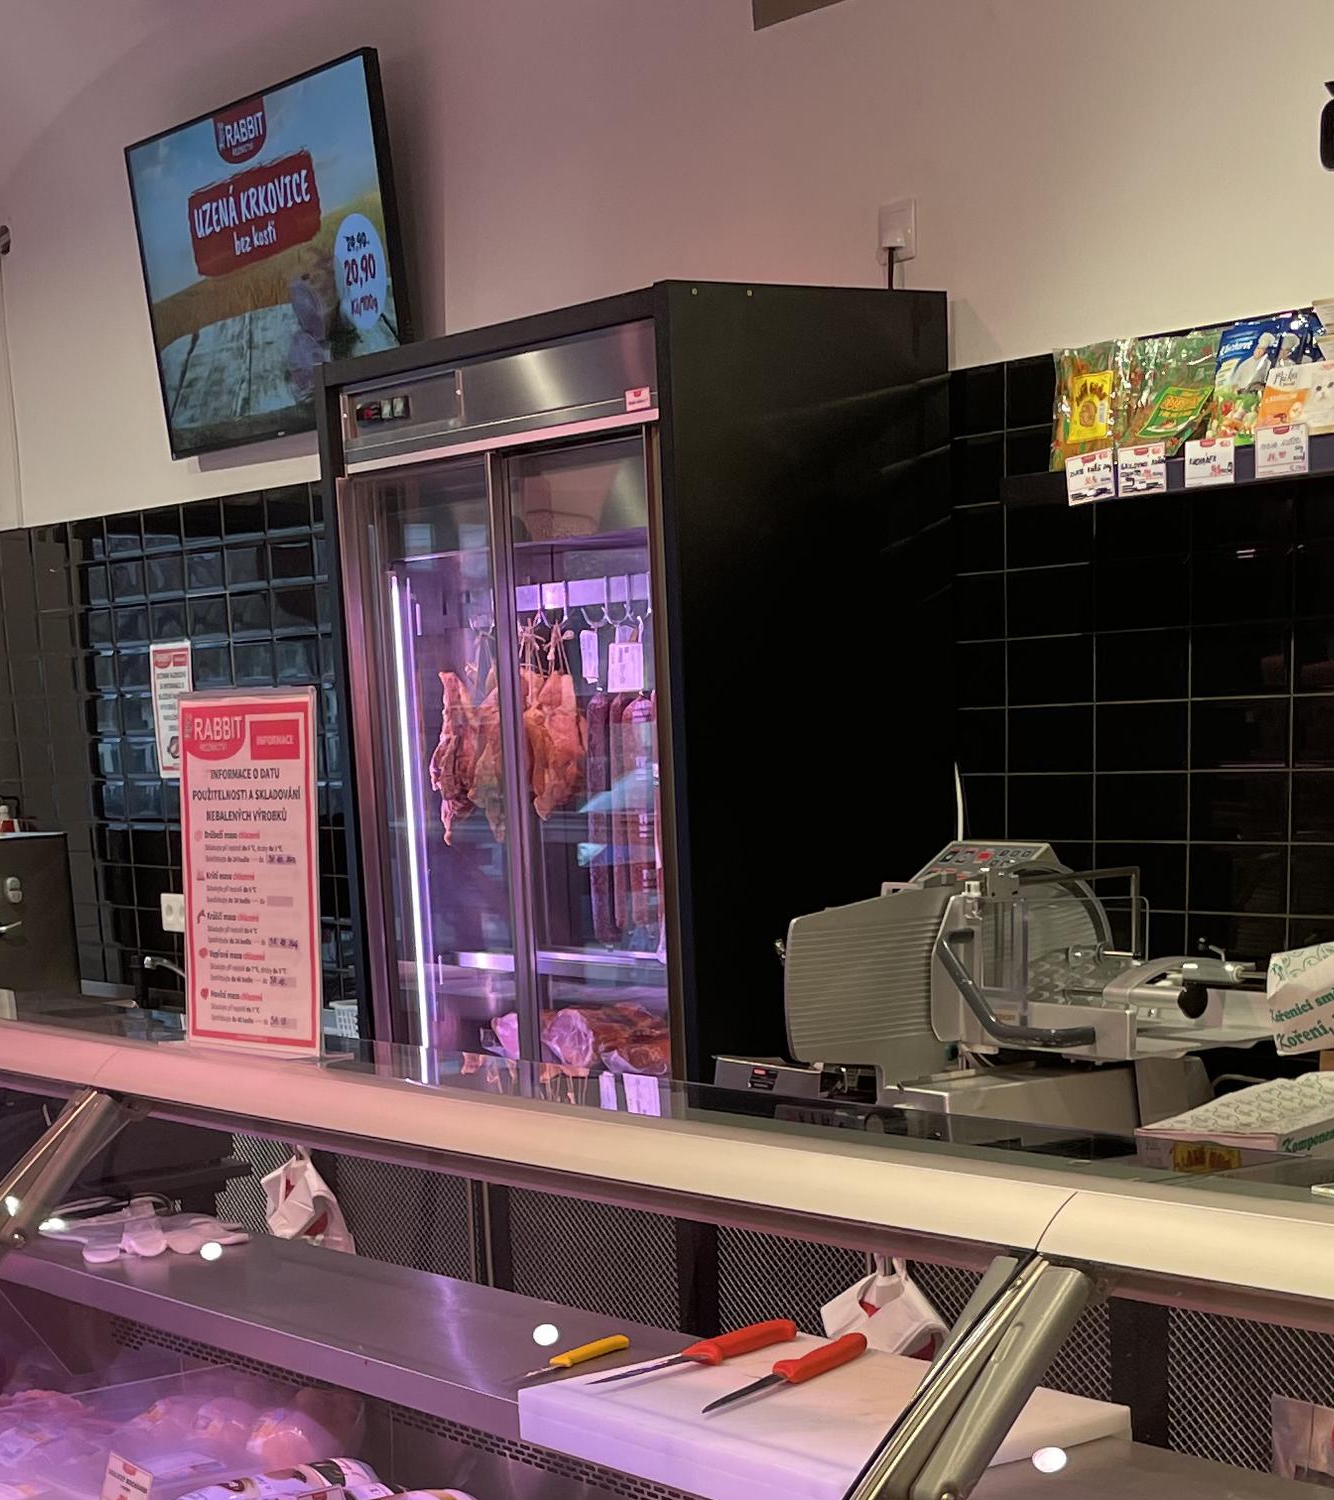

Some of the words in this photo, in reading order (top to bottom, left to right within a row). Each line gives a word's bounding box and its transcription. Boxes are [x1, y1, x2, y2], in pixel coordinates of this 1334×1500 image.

[224, 110, 264, 147] RABBIT
[194, 183, 239, 240] UZENÁ
[239, 169, 311, 223] KRKOVICE
[233, 227, 251, 256] bez
[253, 222, 277, 251] kosti
[344, 253, 376, 289] 20,90
[194, 716, 242, 741] RABBIT
[210, 769, 251, 780] INFORMACE
[261, 768, 280, 779] DATU
[192, 789, 247, 800] POUŽITELNOSTI
[255, 788, 300, 800] SKLADOVÁNÍ
[206, 810, 251, 821] NEBALENÝCH
